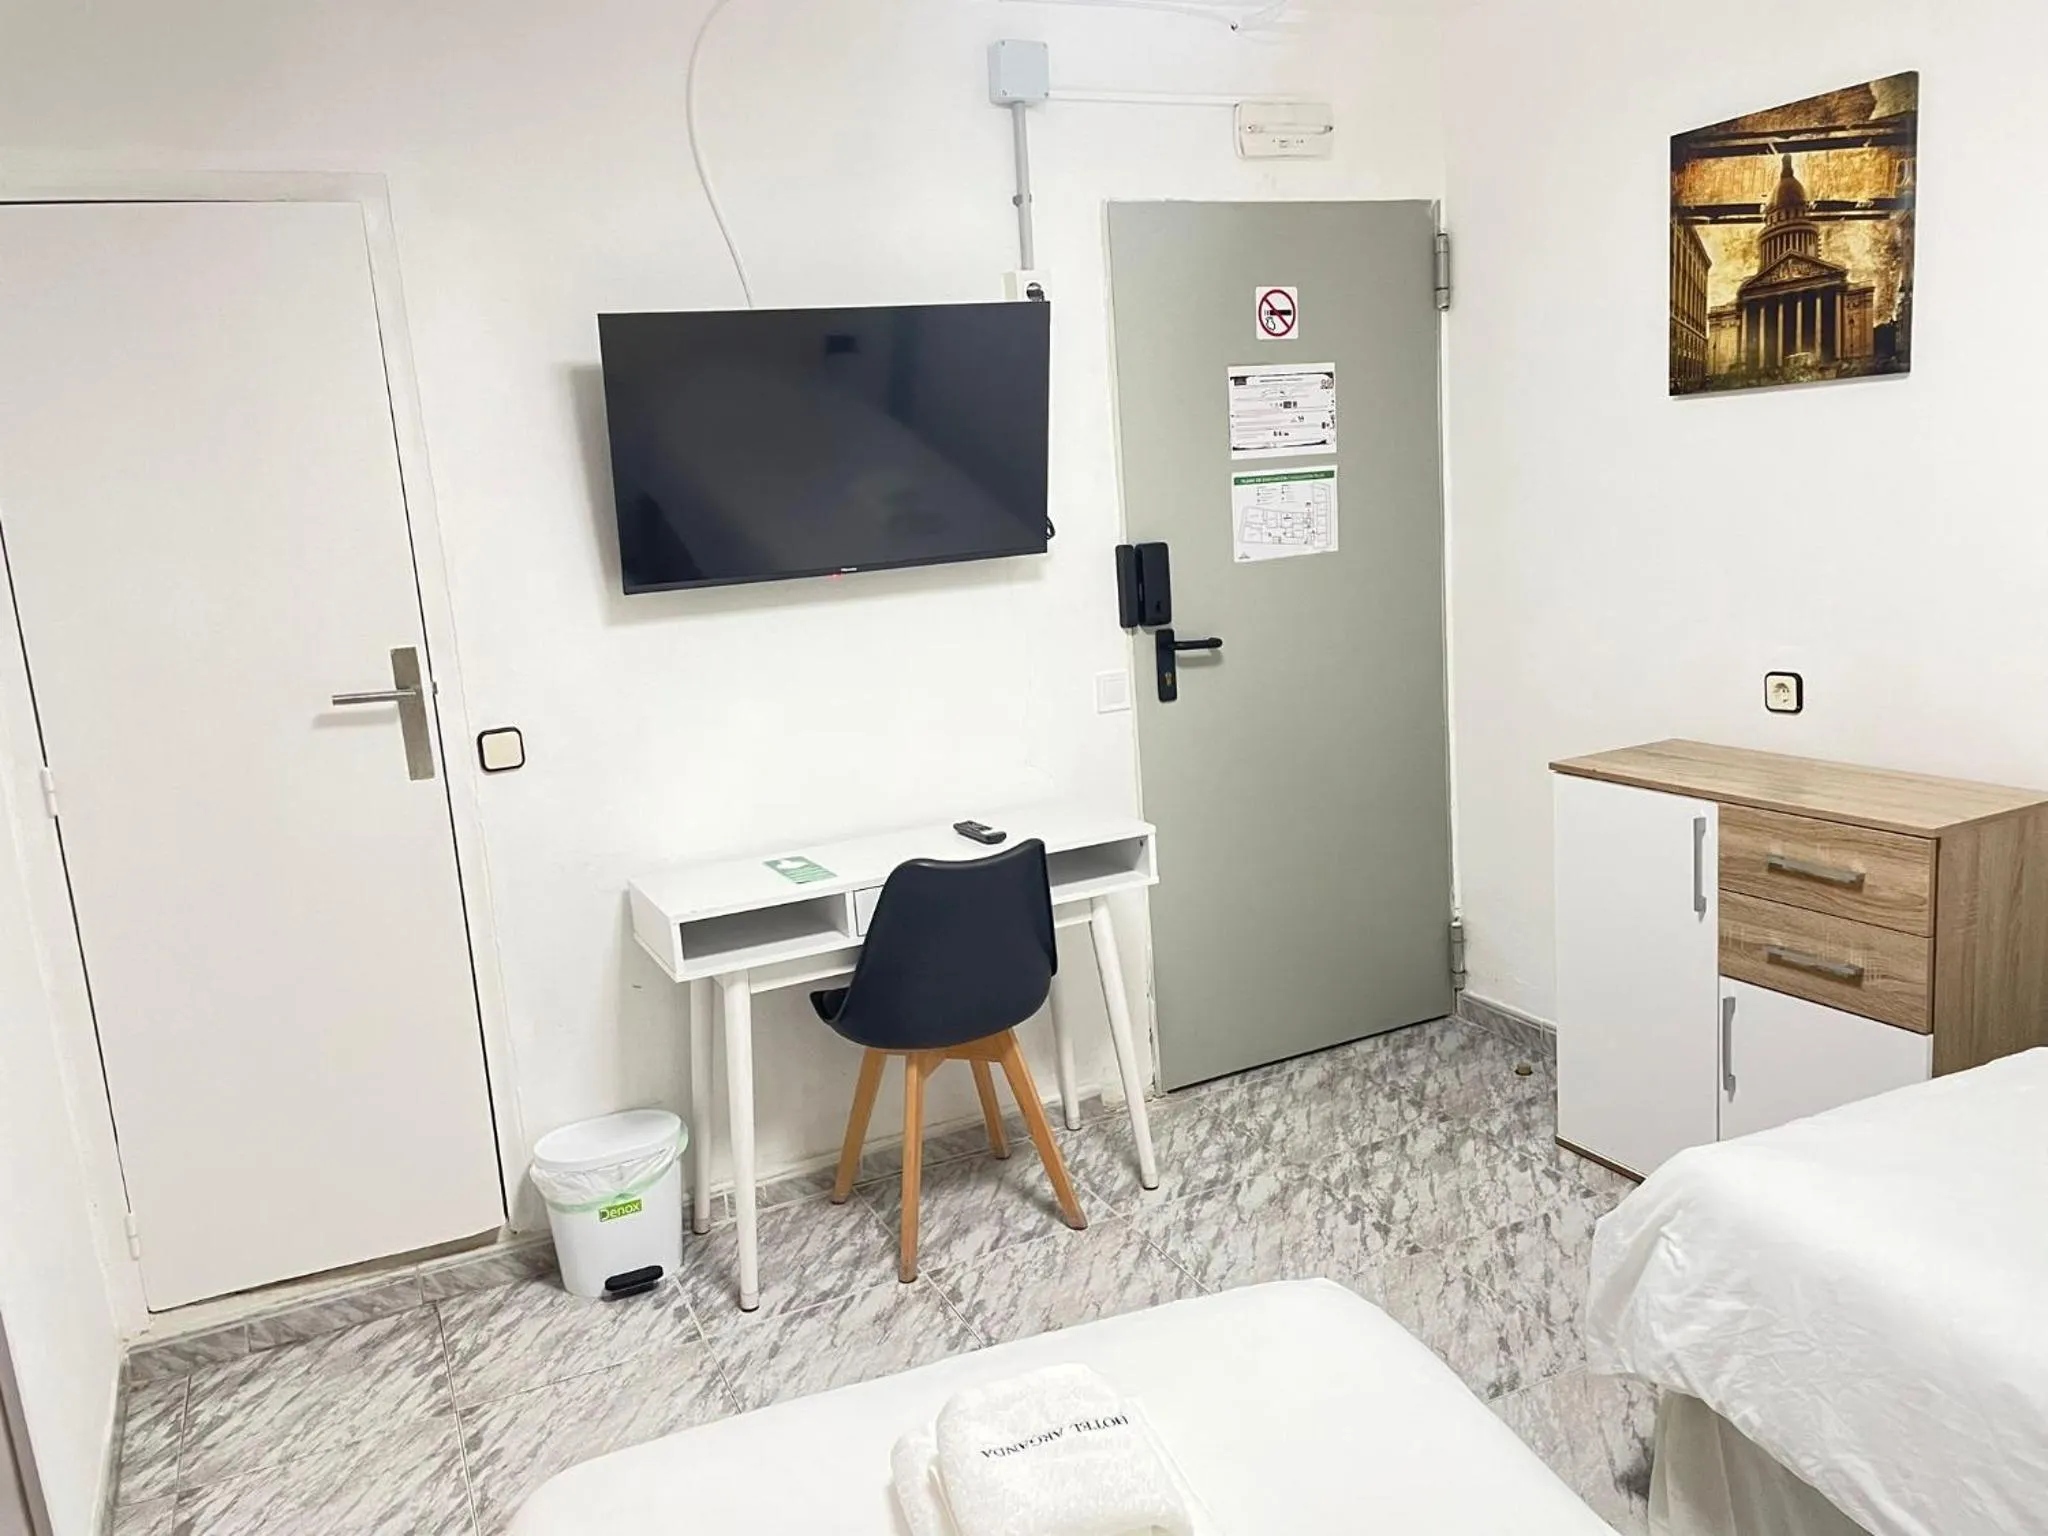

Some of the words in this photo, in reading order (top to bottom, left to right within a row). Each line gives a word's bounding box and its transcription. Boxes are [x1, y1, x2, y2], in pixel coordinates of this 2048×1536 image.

[600, 1201, 640, 1221] Denox
[1070, 1414, 1129, 1434] HOTEL
[980, 1427, 1064, 1459] ARGANDA
